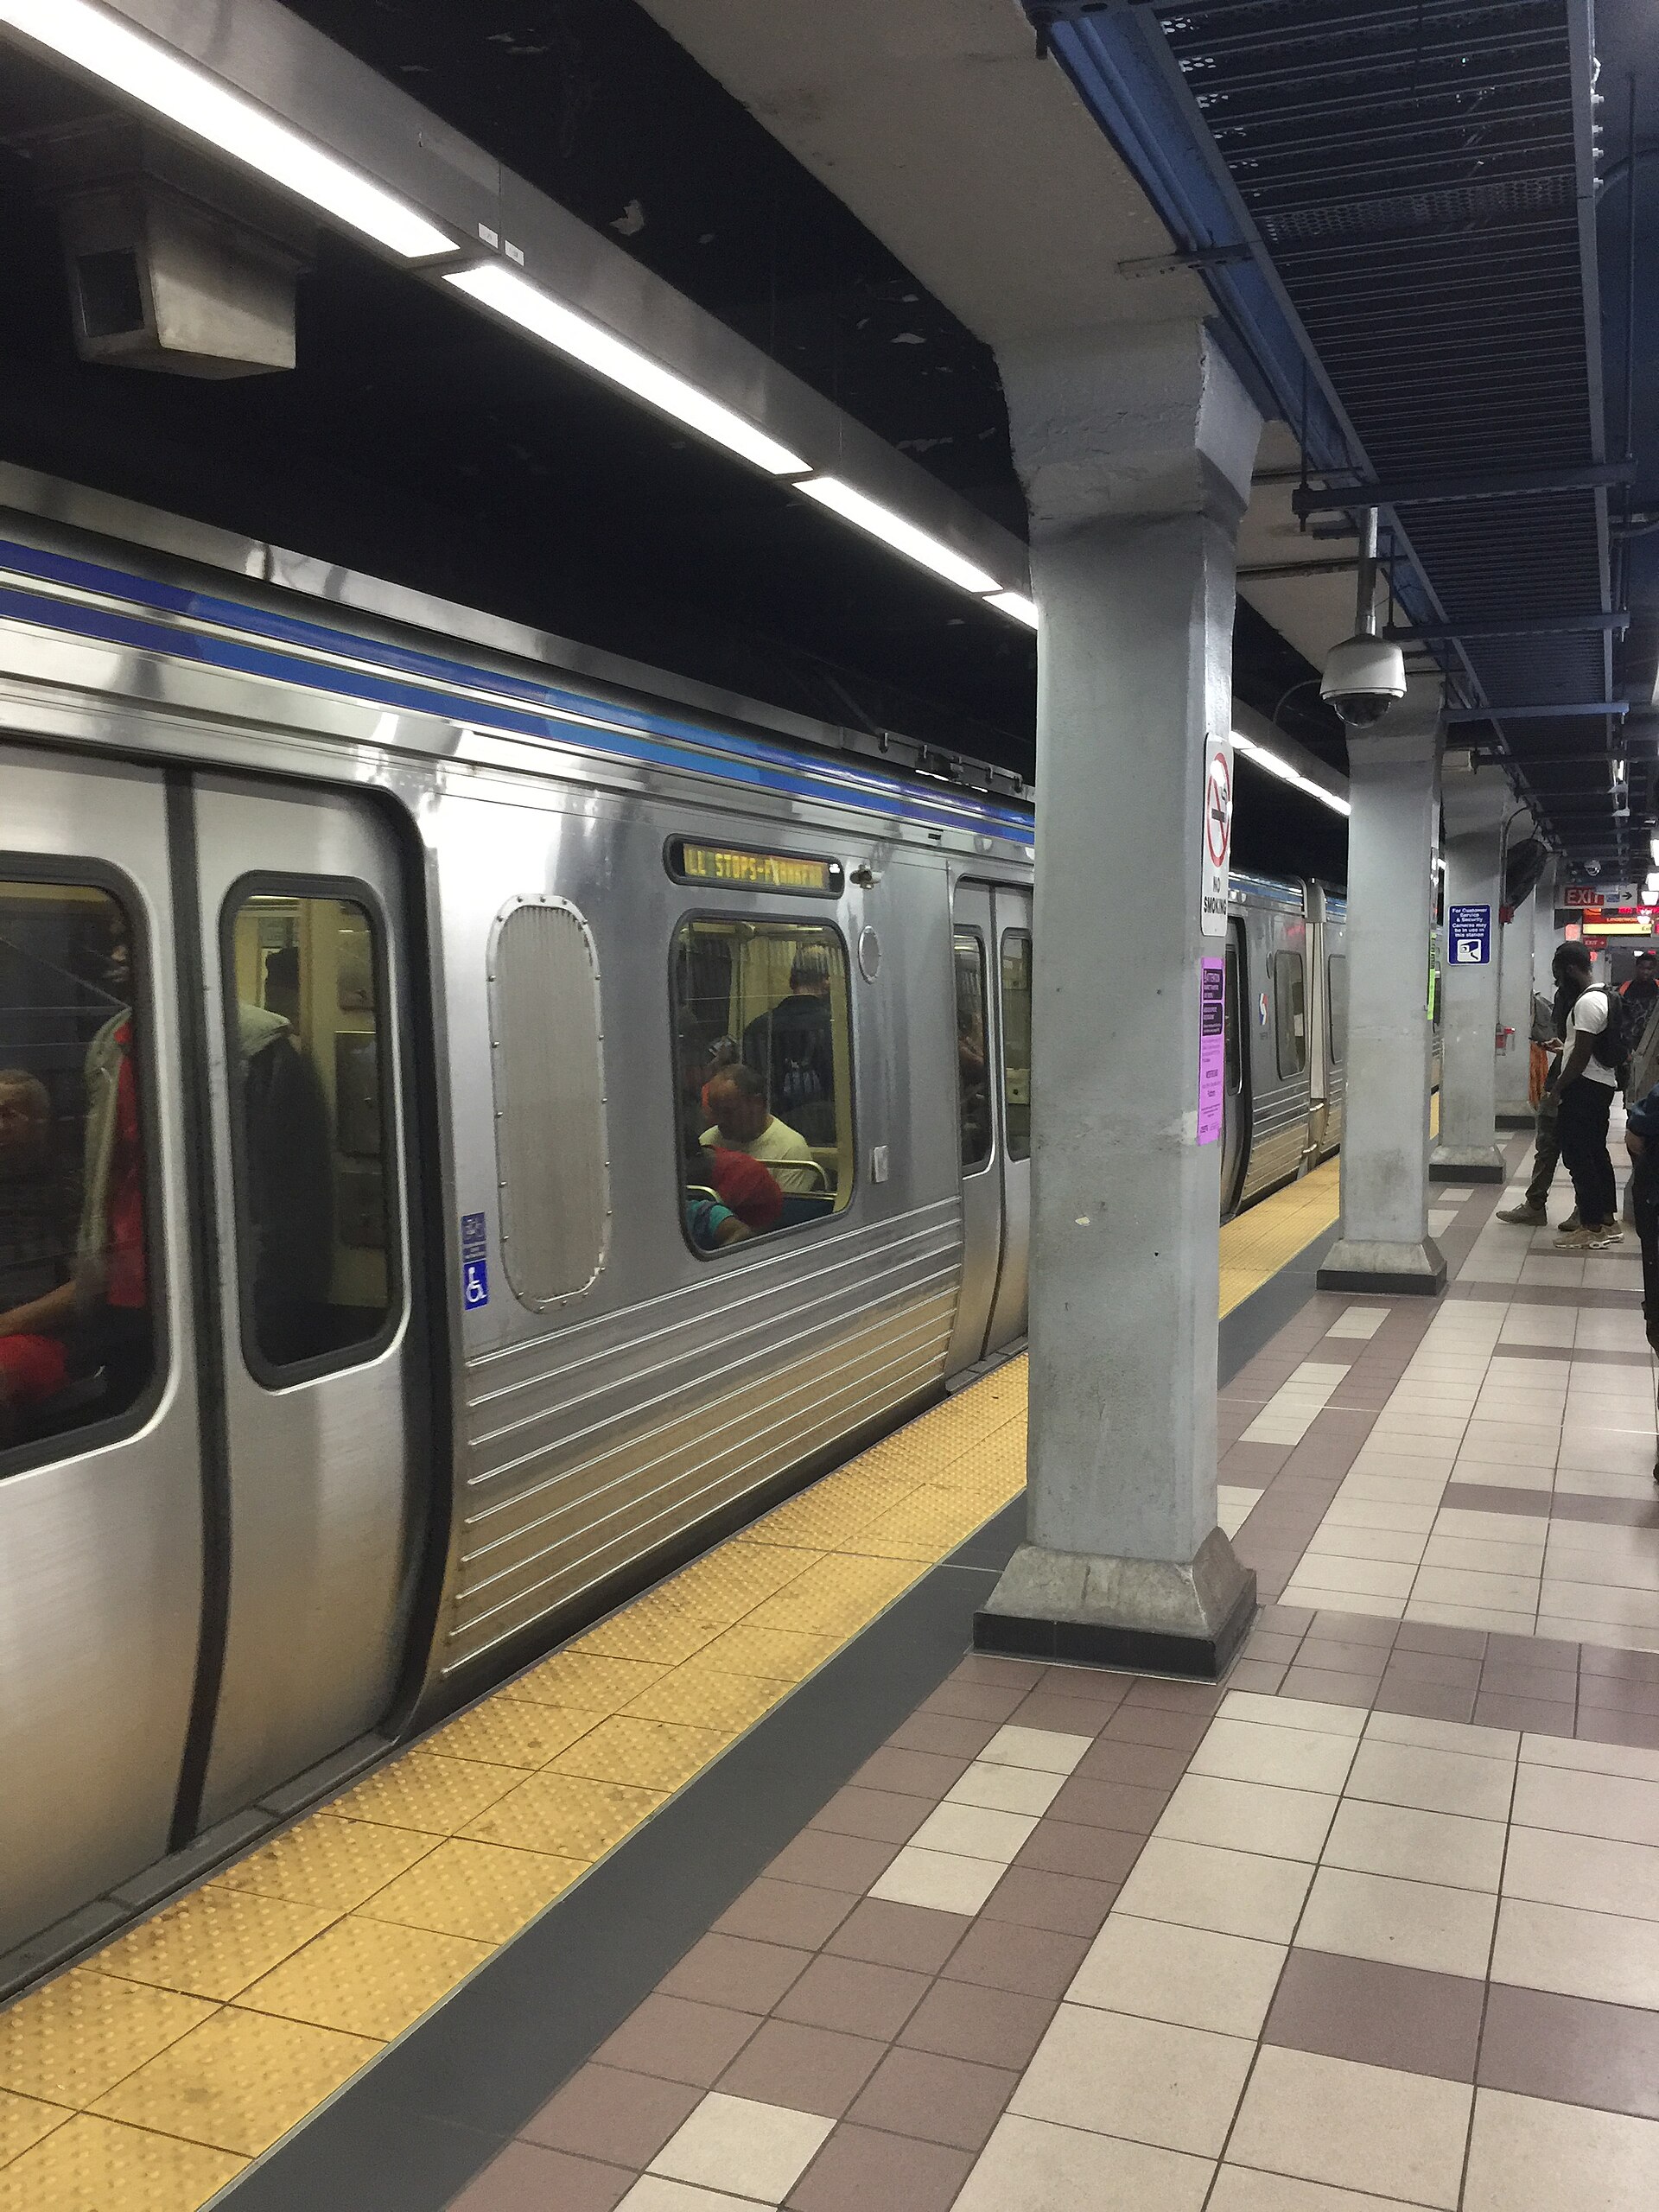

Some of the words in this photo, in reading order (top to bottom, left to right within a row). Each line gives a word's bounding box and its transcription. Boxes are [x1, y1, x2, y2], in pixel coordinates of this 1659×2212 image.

[1212, 875, 1220, 893] NO
[1204, 895, 1227, 916] SMOKING
[1567, 889, 1599, 904] EXIT
